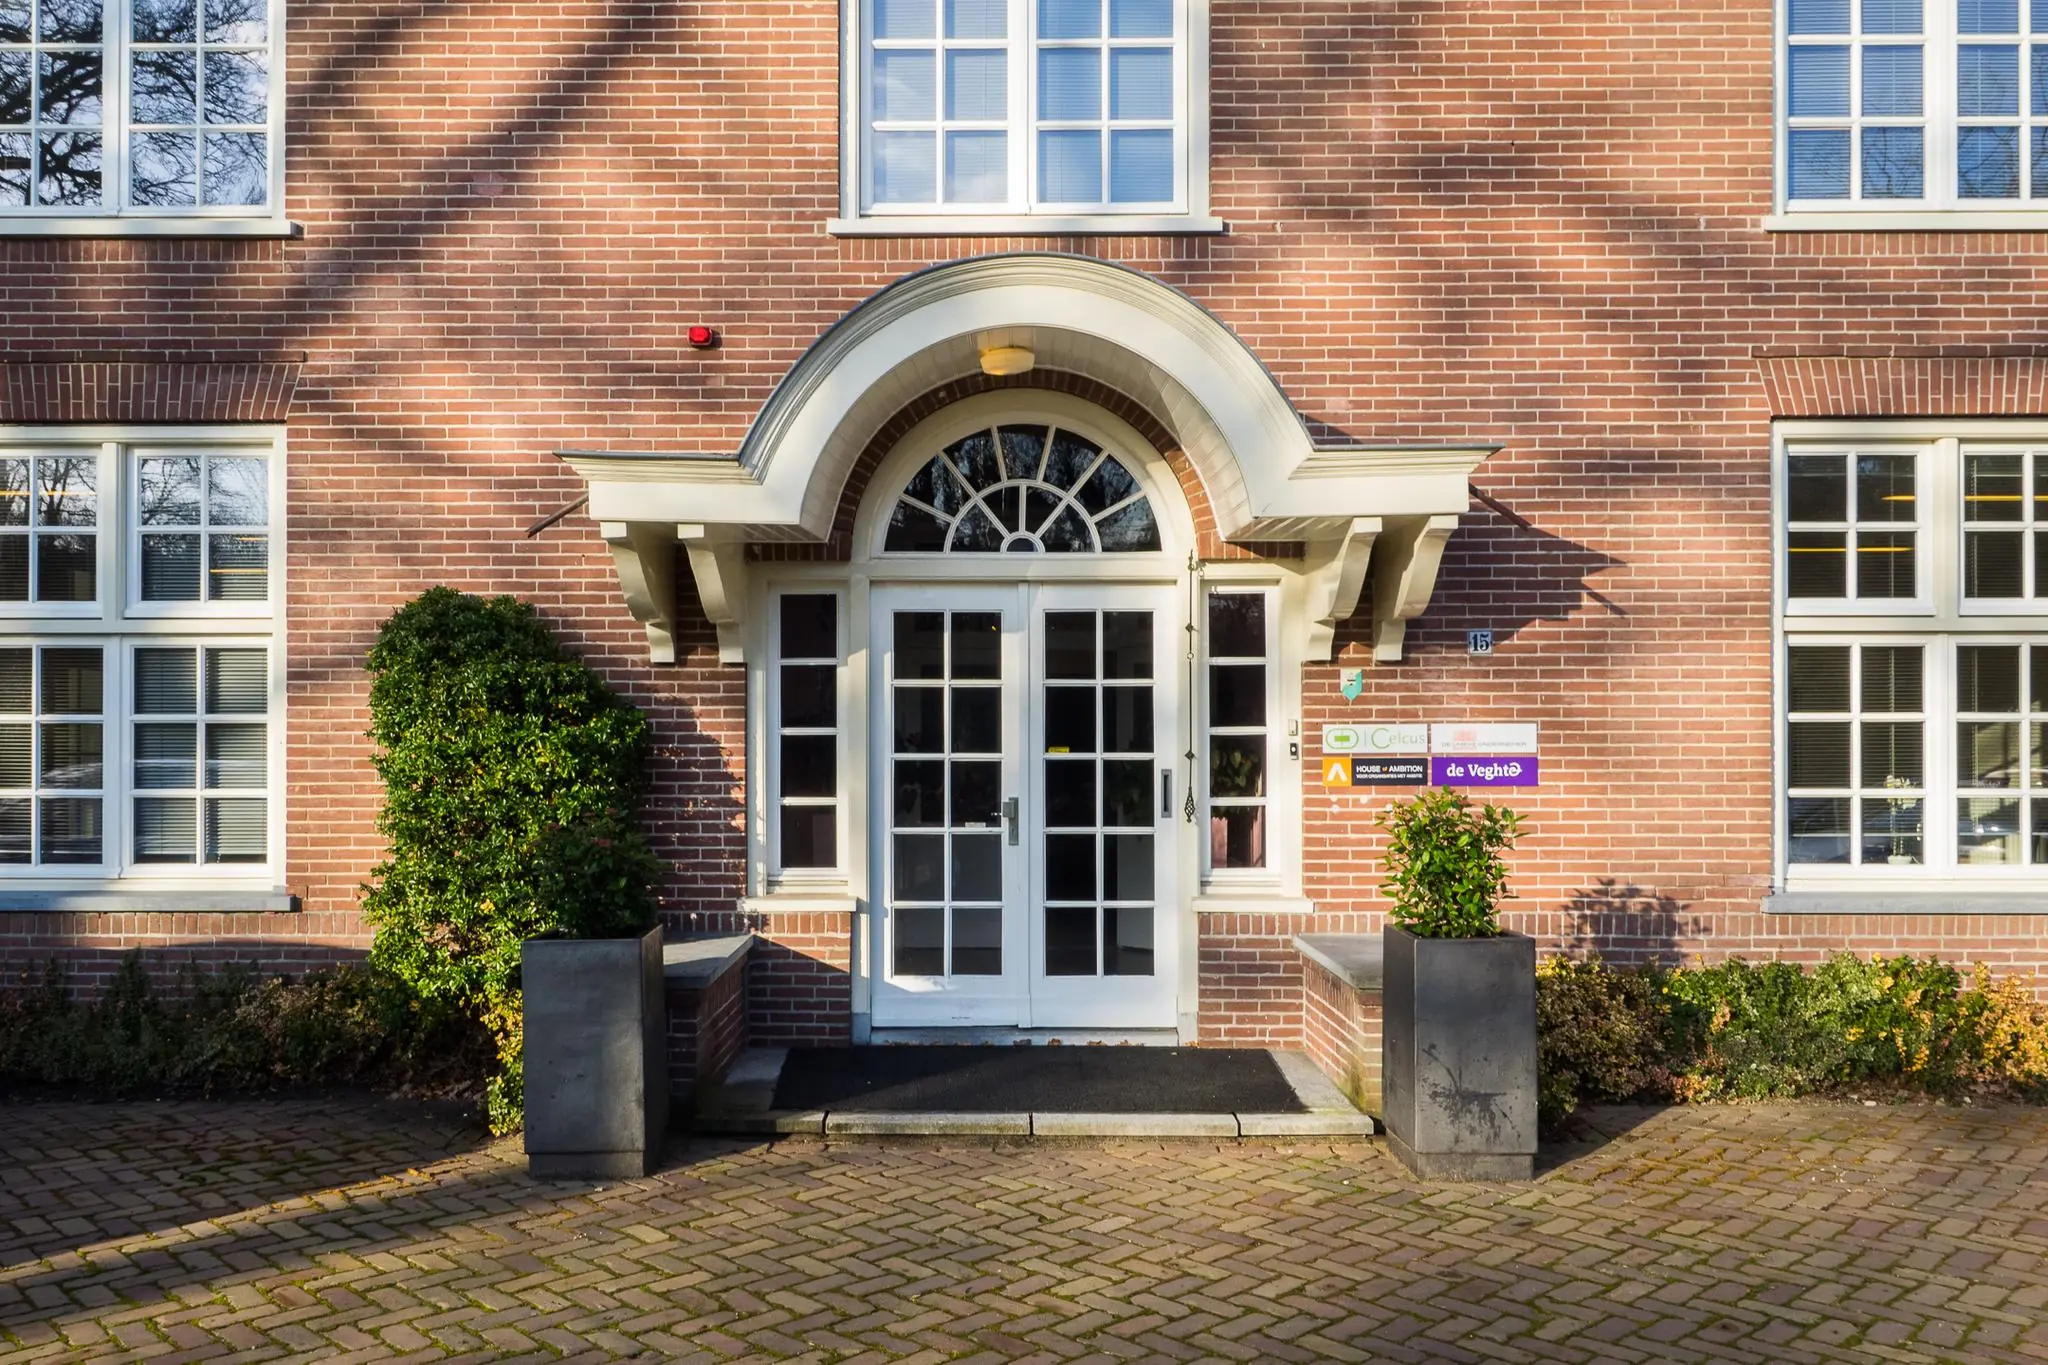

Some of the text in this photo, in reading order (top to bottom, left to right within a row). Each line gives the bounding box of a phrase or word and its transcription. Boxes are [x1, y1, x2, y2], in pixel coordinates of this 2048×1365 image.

[1470, 633, 1489, 651] 15
[1371, 728, 1425, 749] Celcus
[1356, 765, 1381, 773] HOUSE
[1389, 765, 1423, 773] AMBITION
[1446, 762, 1464, 776] de
